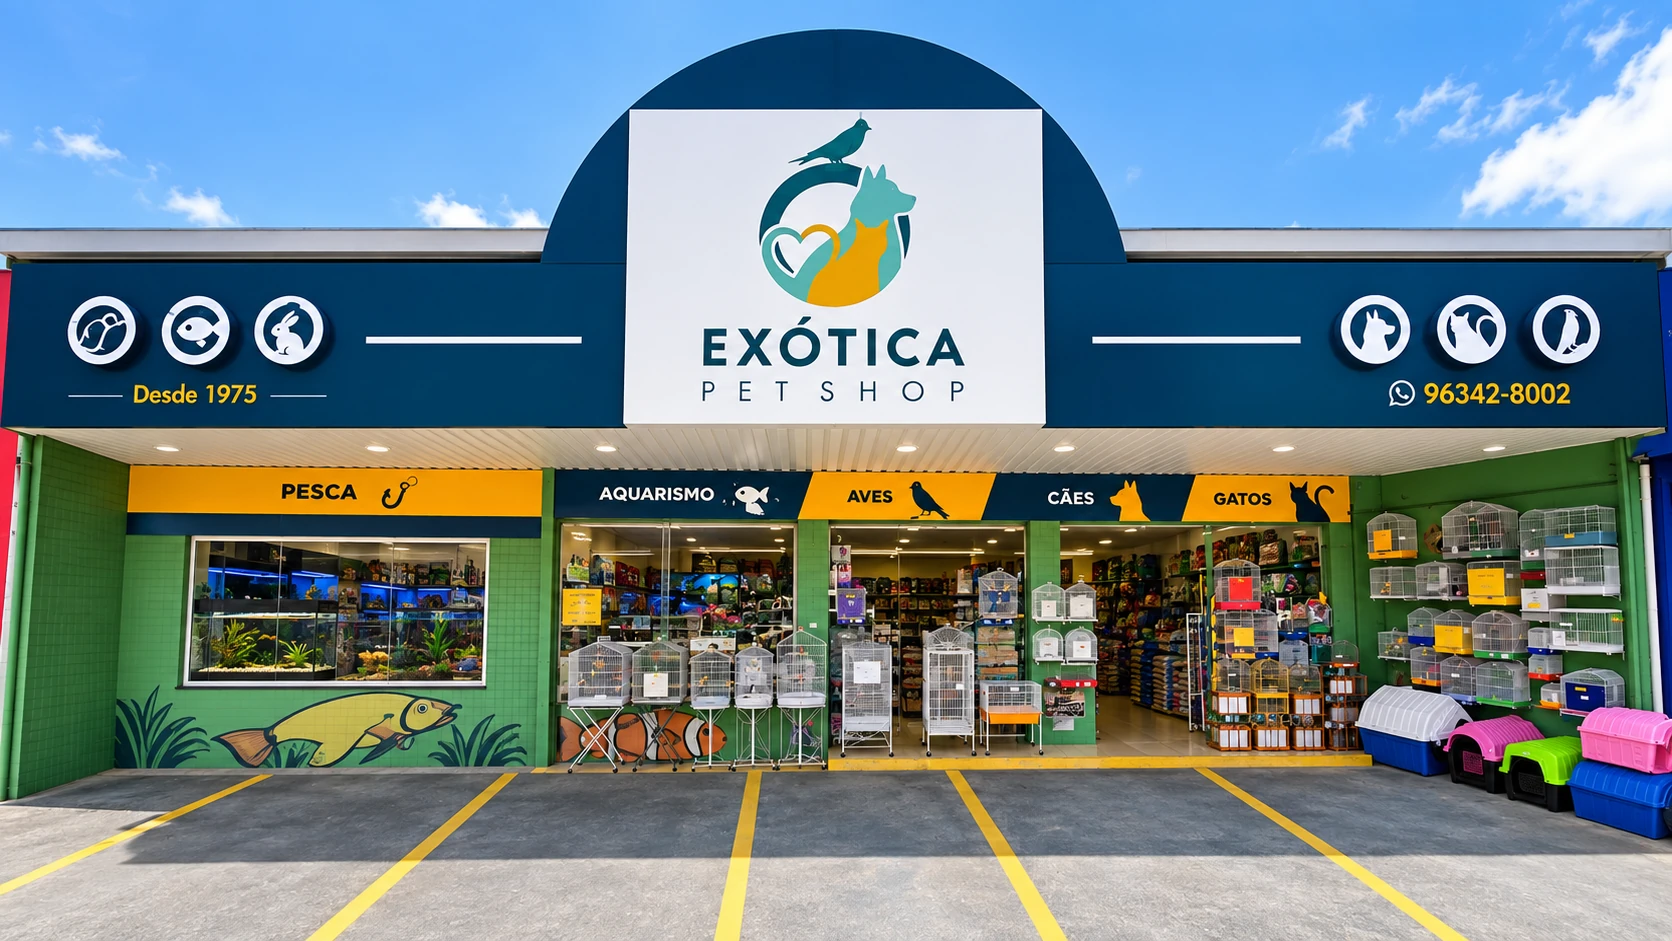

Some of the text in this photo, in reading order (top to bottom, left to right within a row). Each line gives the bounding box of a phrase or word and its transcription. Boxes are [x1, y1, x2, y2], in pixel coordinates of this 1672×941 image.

[703, 316, 965, 367] EXÓTICA
[133, 384, 257, 404] Desde 1975
[702, 381, 965, 402] PET SHOP
[1424, 383, 1571, 405] 96342-8002
[281, 483, 357, 500] PESCA
[599, 486, 715, 502] AQUARISMO
[847, 489, 893, 504] AVES
[1047, 487, 1095, 506] CÃES
[1213, 492, 1272, 506] GATOS
